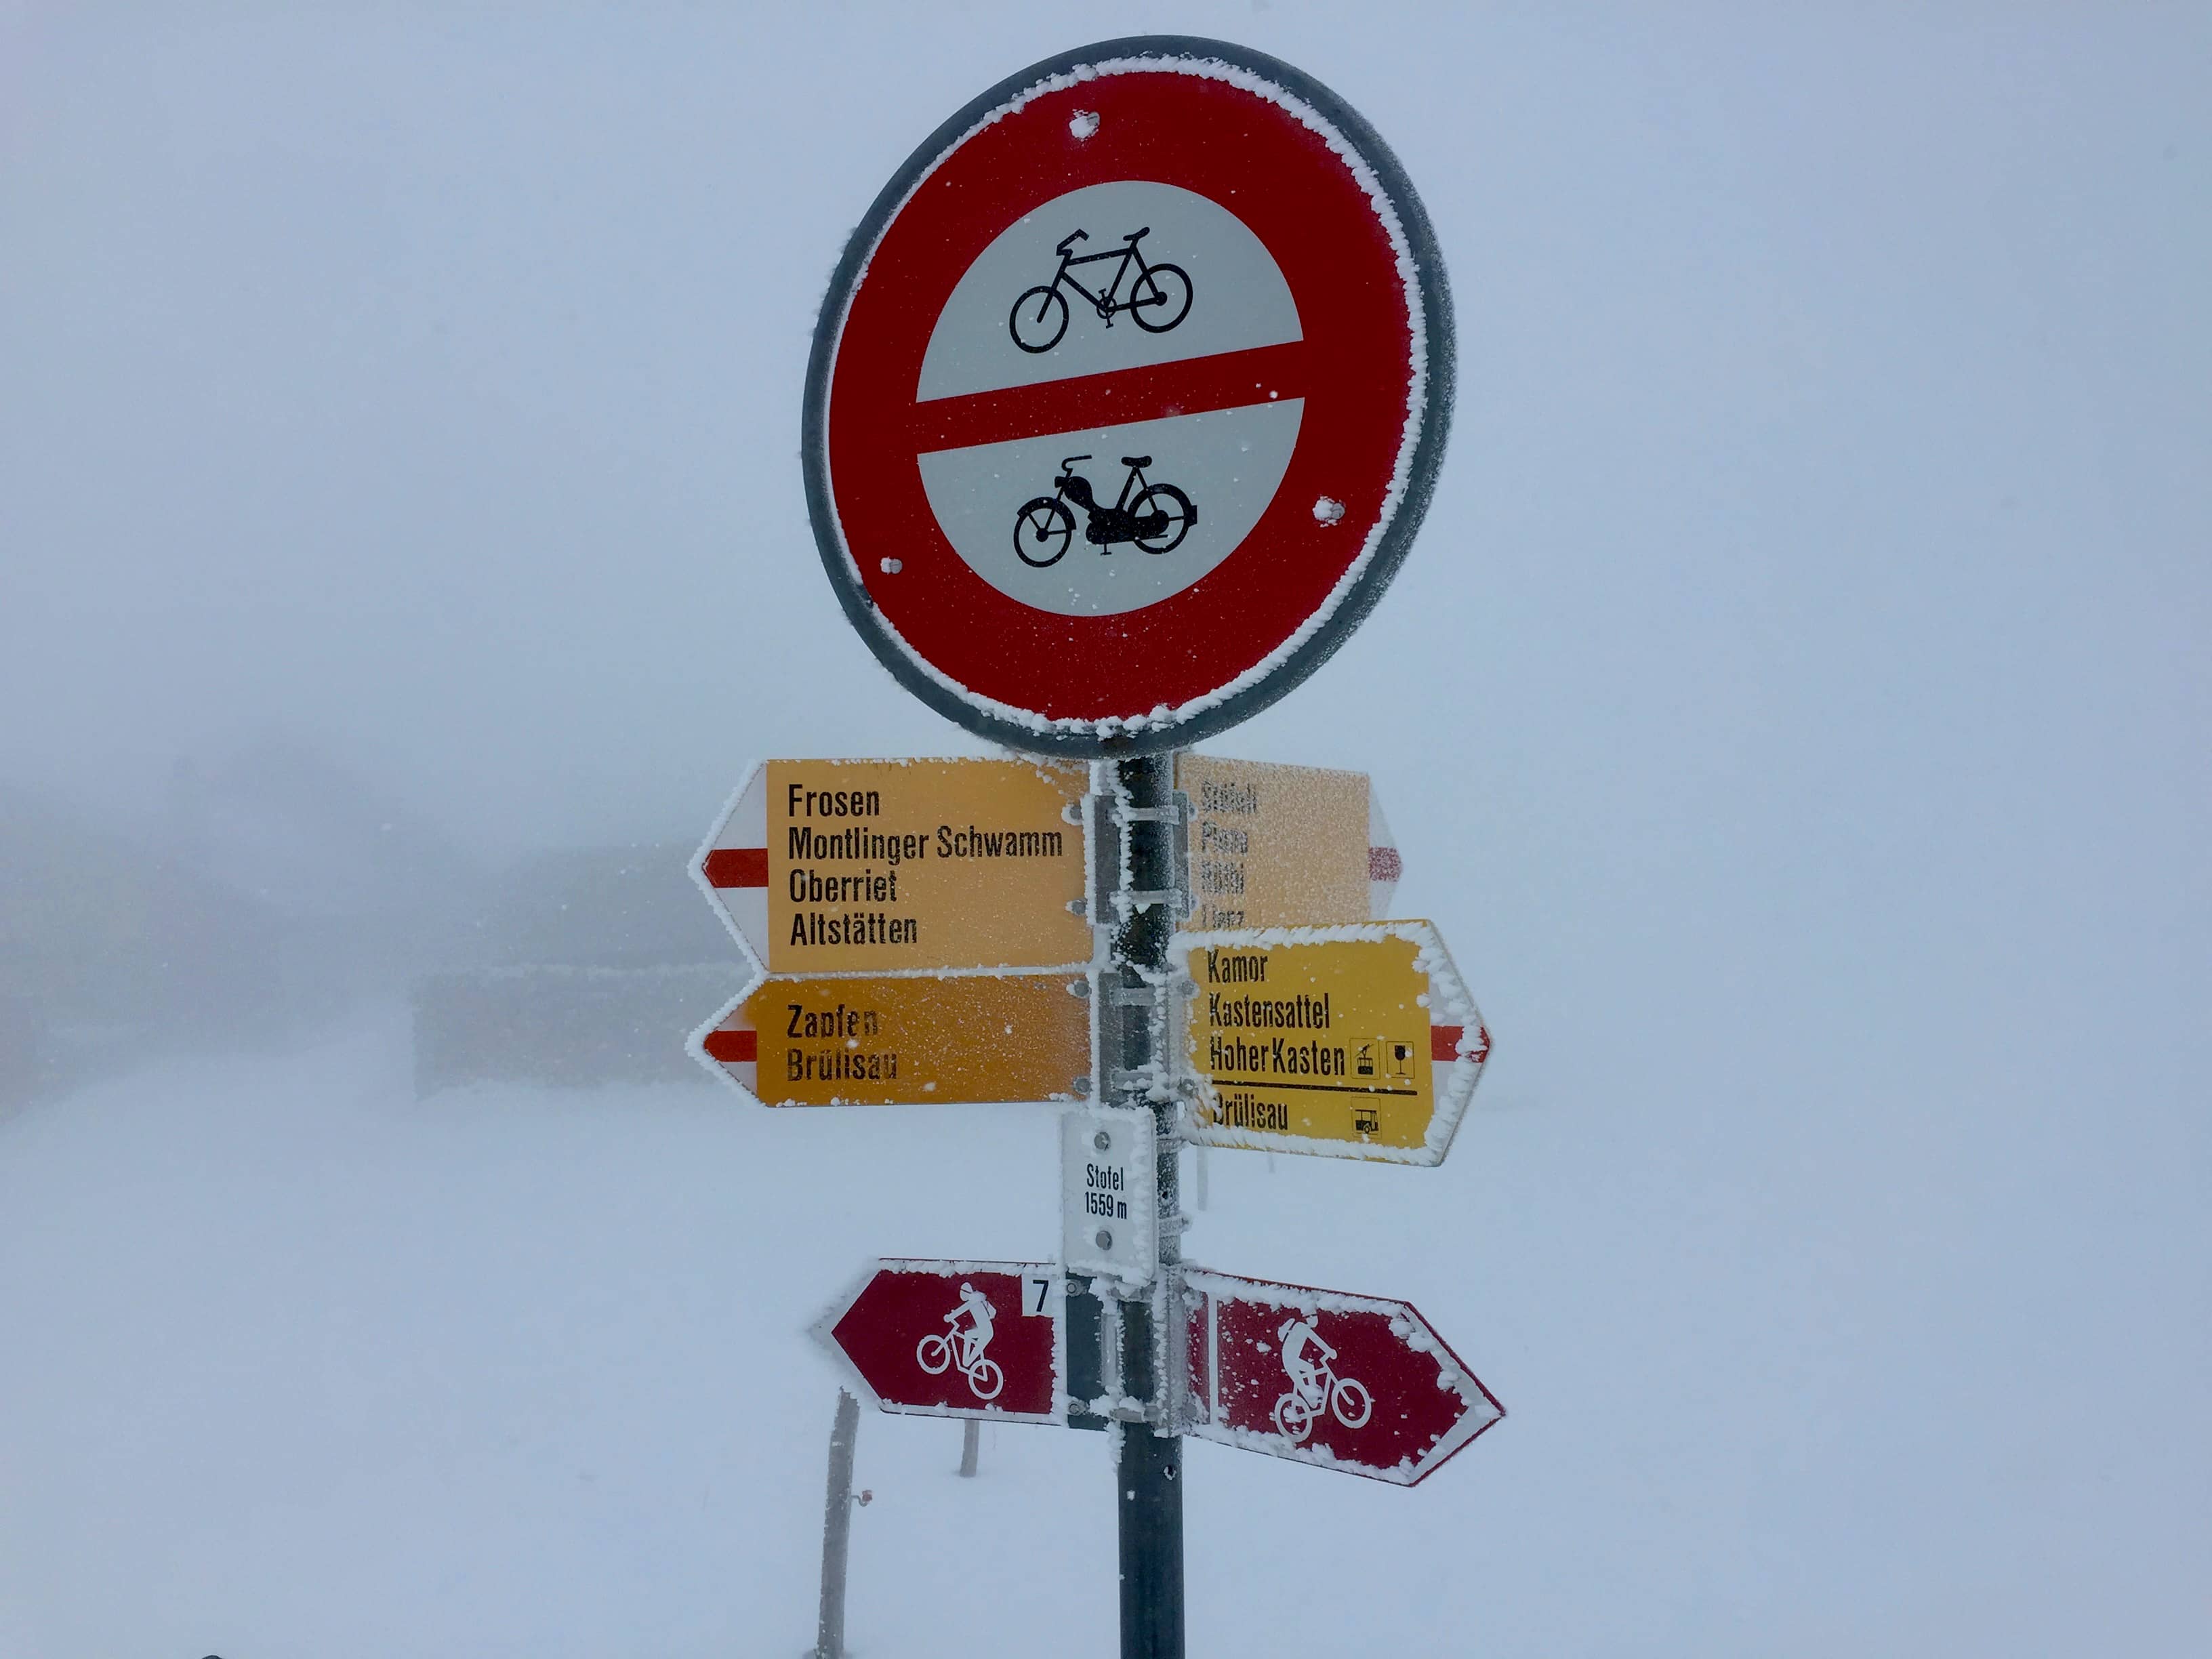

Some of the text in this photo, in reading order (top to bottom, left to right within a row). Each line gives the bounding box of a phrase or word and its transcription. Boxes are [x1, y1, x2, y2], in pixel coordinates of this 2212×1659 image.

[788, 783, 880, 817] Frosen
[788, 825, 1063, 865] Montlinger Schwamm
[790, 868, 897, 903] Oberriet
[790, 912, 918, 946] Altstätten
[1207, 949, 1268, 983] Kamor
[787, 1004, 878, 1038] Zapfen
[1209, 992, 1330, 1029] Kastensattel
[787, 1048, 897, 1082] Brülisau
[1210, 1036, 1345, 1076] Hoher Kasten
[1086, 1163, 1124, 1191] Stofel
[1085, 1191, 1127, 1220] 1559 m
[1032, 1279, 1049, 1313] 7
